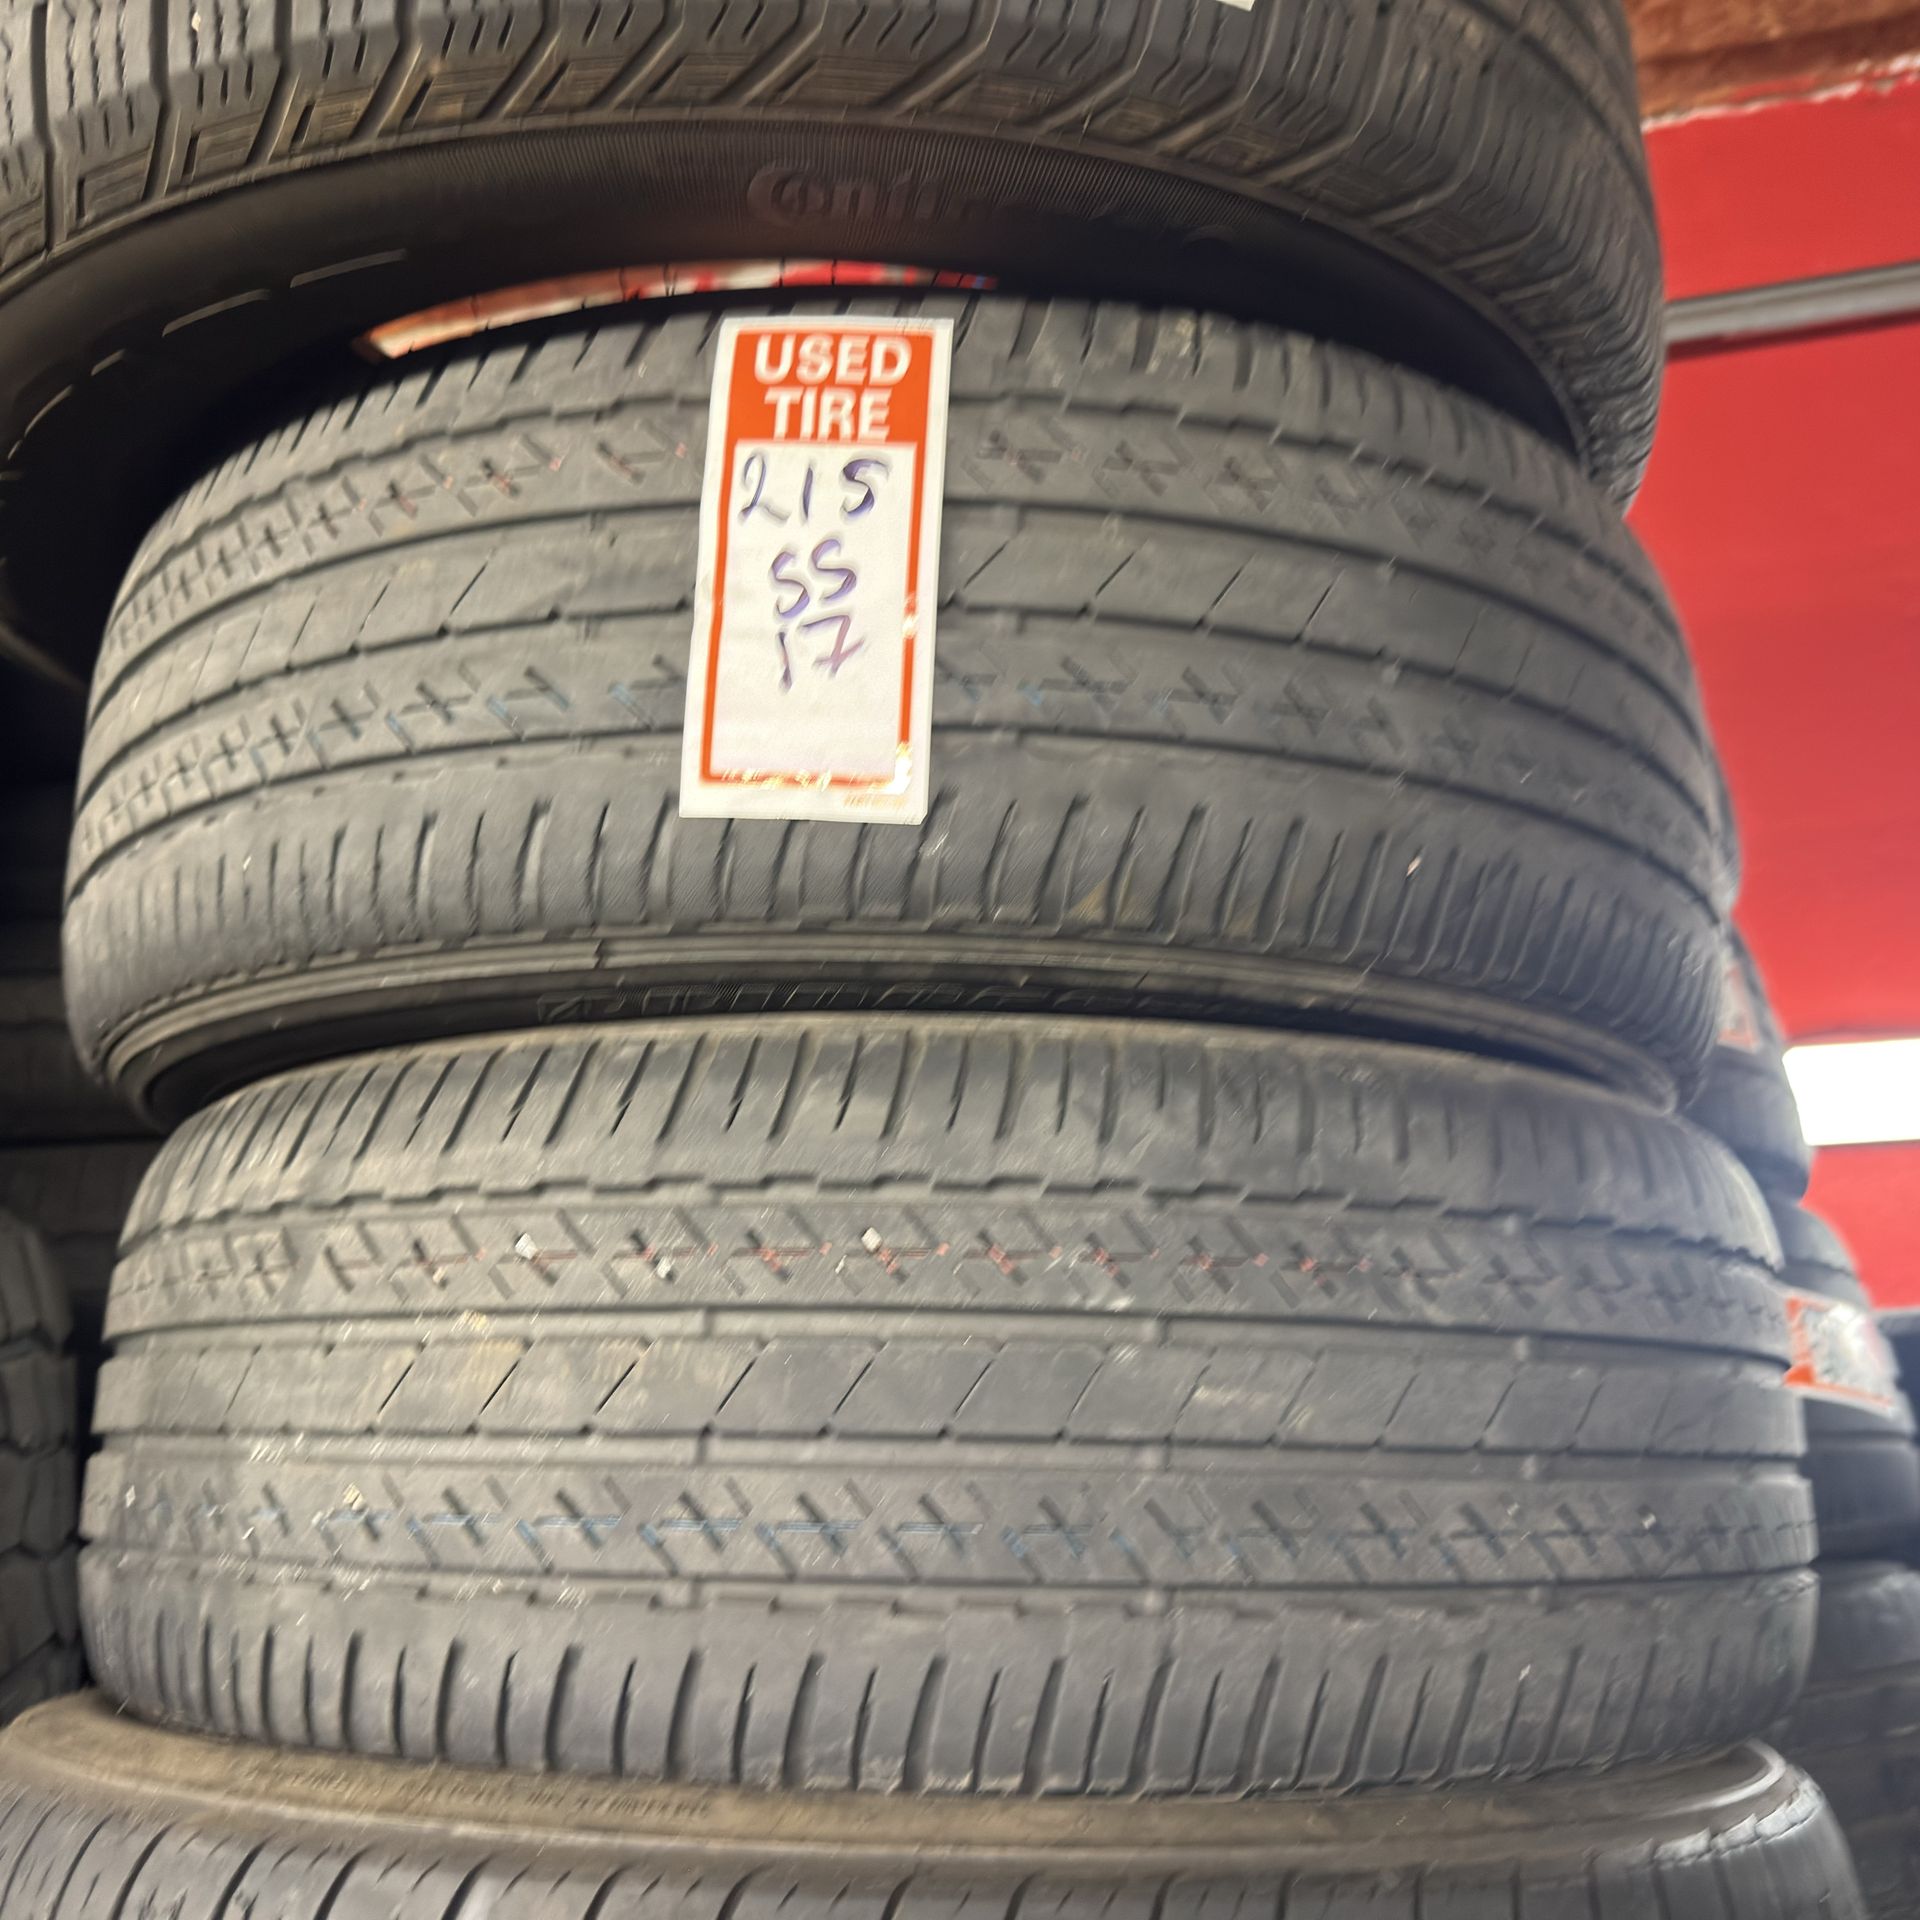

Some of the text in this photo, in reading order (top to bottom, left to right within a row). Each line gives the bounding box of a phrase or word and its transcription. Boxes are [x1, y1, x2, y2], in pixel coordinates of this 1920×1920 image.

[753, 333, 912, 386] USED
[764, 385, 893, 442] TIRE
[778, 613, 866, 692] 17
